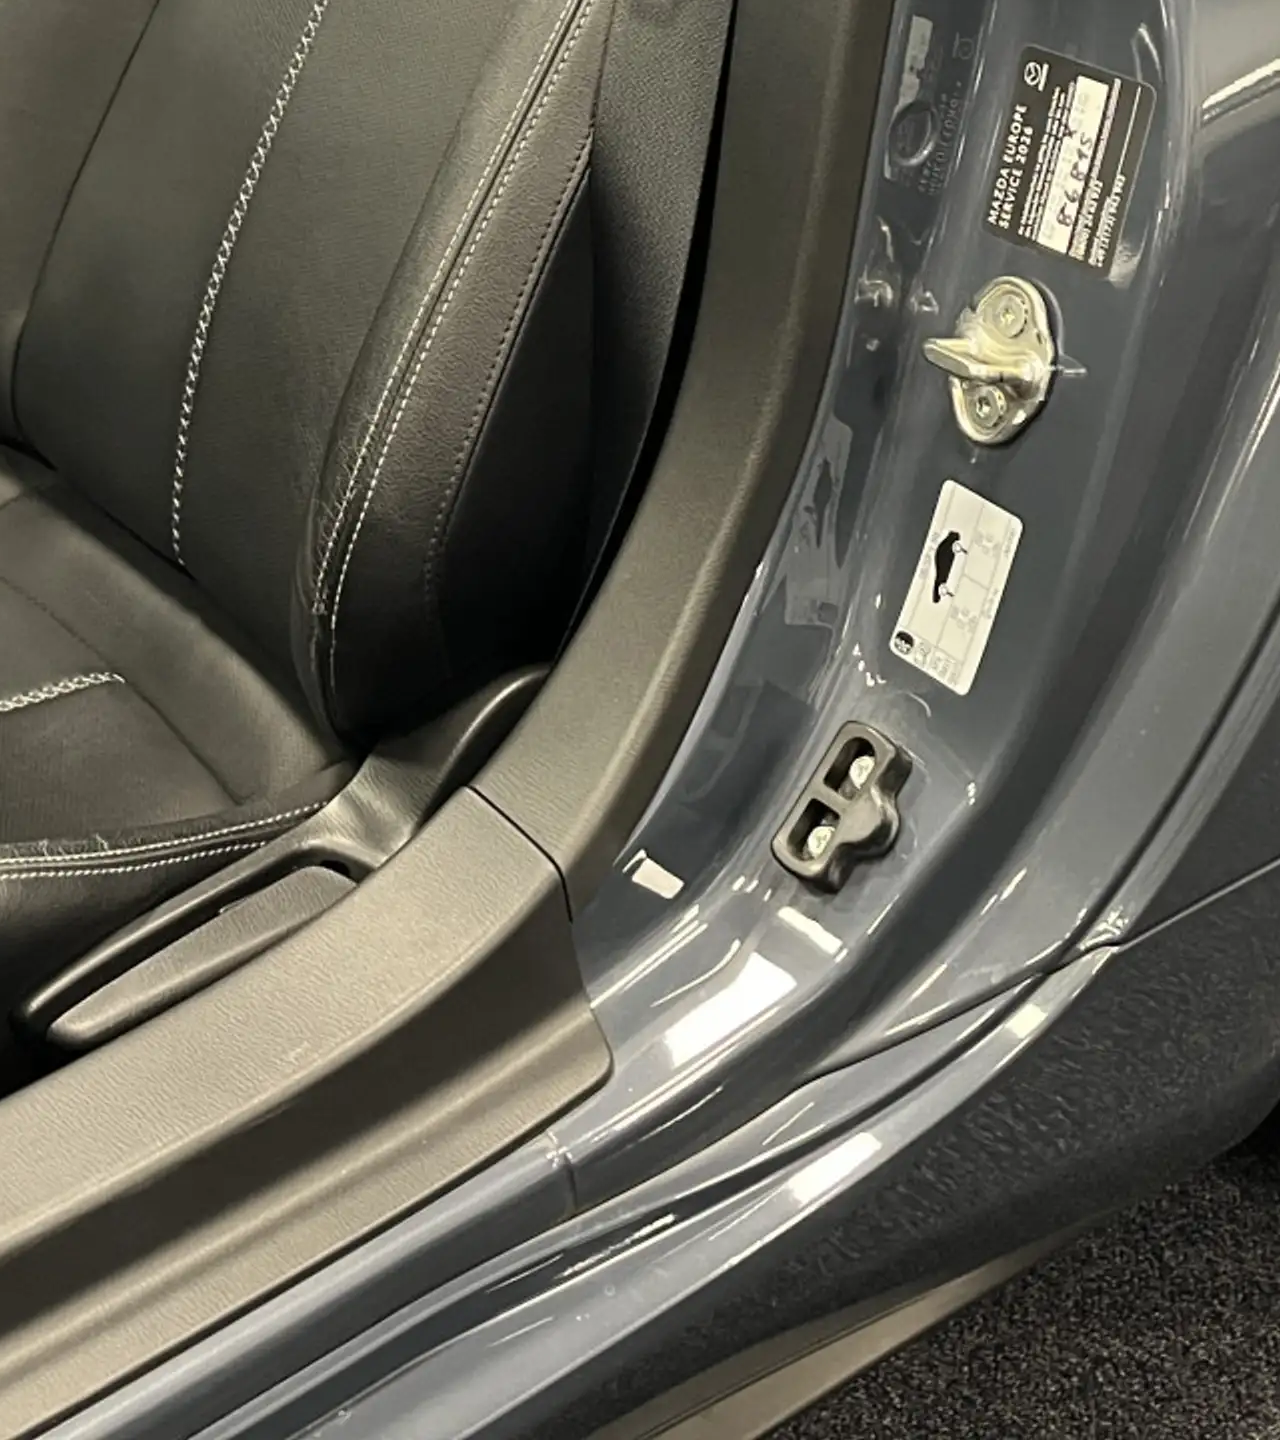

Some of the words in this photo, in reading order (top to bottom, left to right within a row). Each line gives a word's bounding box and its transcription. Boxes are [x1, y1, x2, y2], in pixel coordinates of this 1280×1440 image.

[988, 168, 1011, 225] MAZDA
[1003, 103, 1028, 164] EUROPE
[998, 168, 1024, 230] SERVICE
[1016, 125, 1034, 165] 2026
